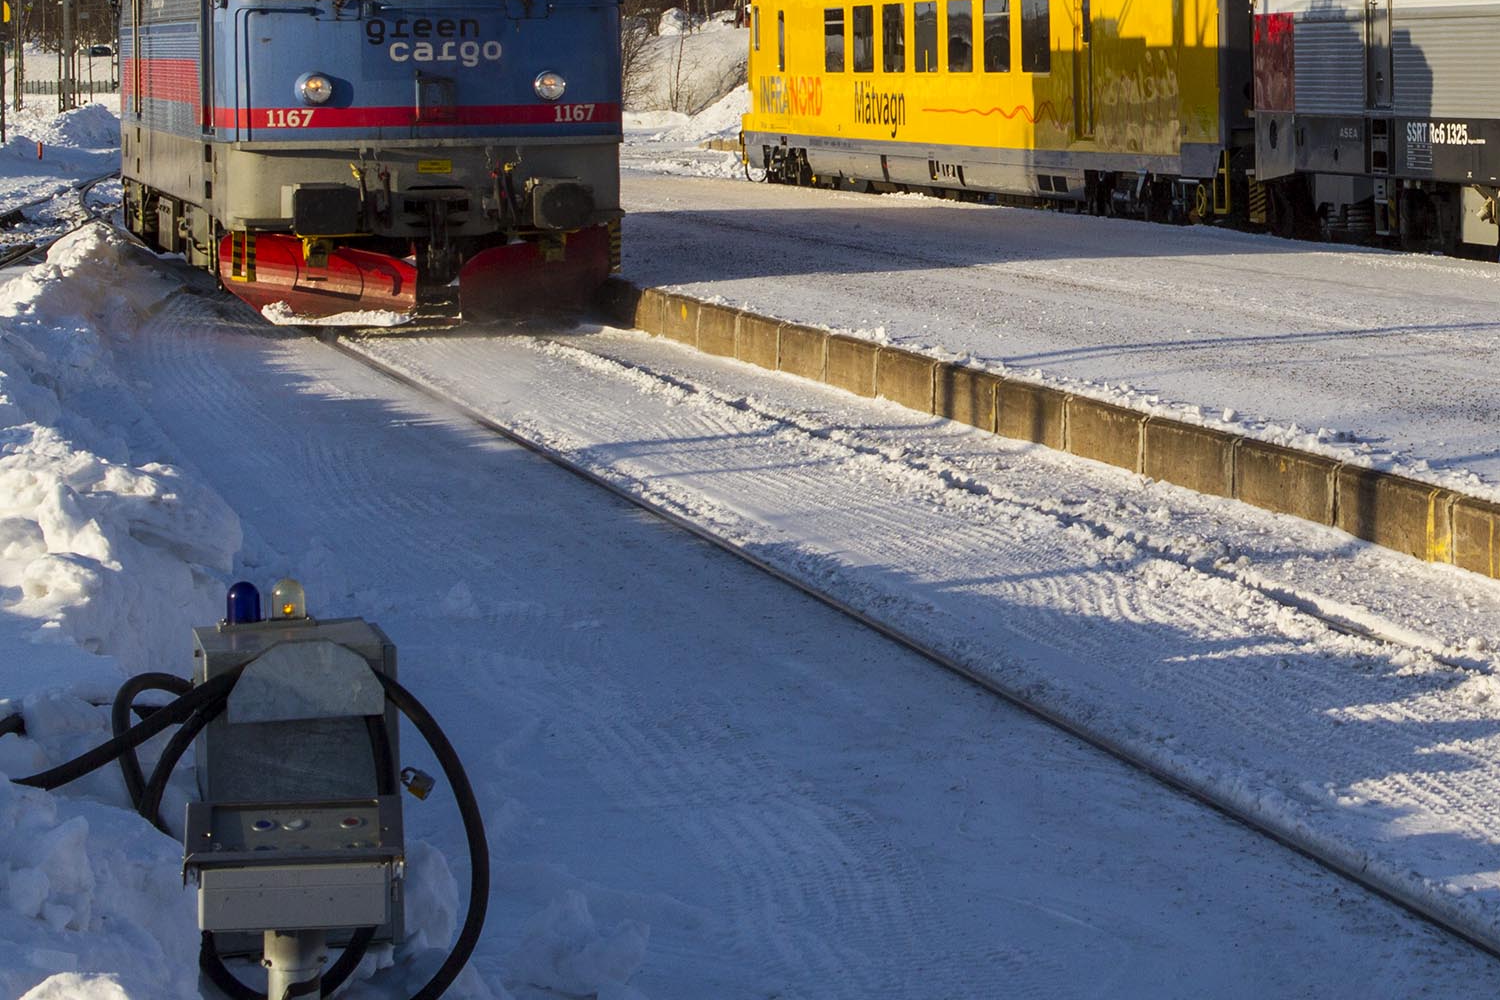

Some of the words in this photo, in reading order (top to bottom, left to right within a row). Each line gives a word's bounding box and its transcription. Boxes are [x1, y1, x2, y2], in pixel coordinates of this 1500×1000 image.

[366, 18, 480, 45] green
[389, 40, 502, 67] cargo
[266, 109, 314, 128] 1167
[554, 104, 596, 122] 1167
[854, 80, 905, 138] Mätvagn
[1339, 128, 1358, 138] ASEA
[1406, 122, 1427, 142] SSRT
[1429, 123, 1446, 144] Rc6
[1446, 124, 1468, 145] 1325
